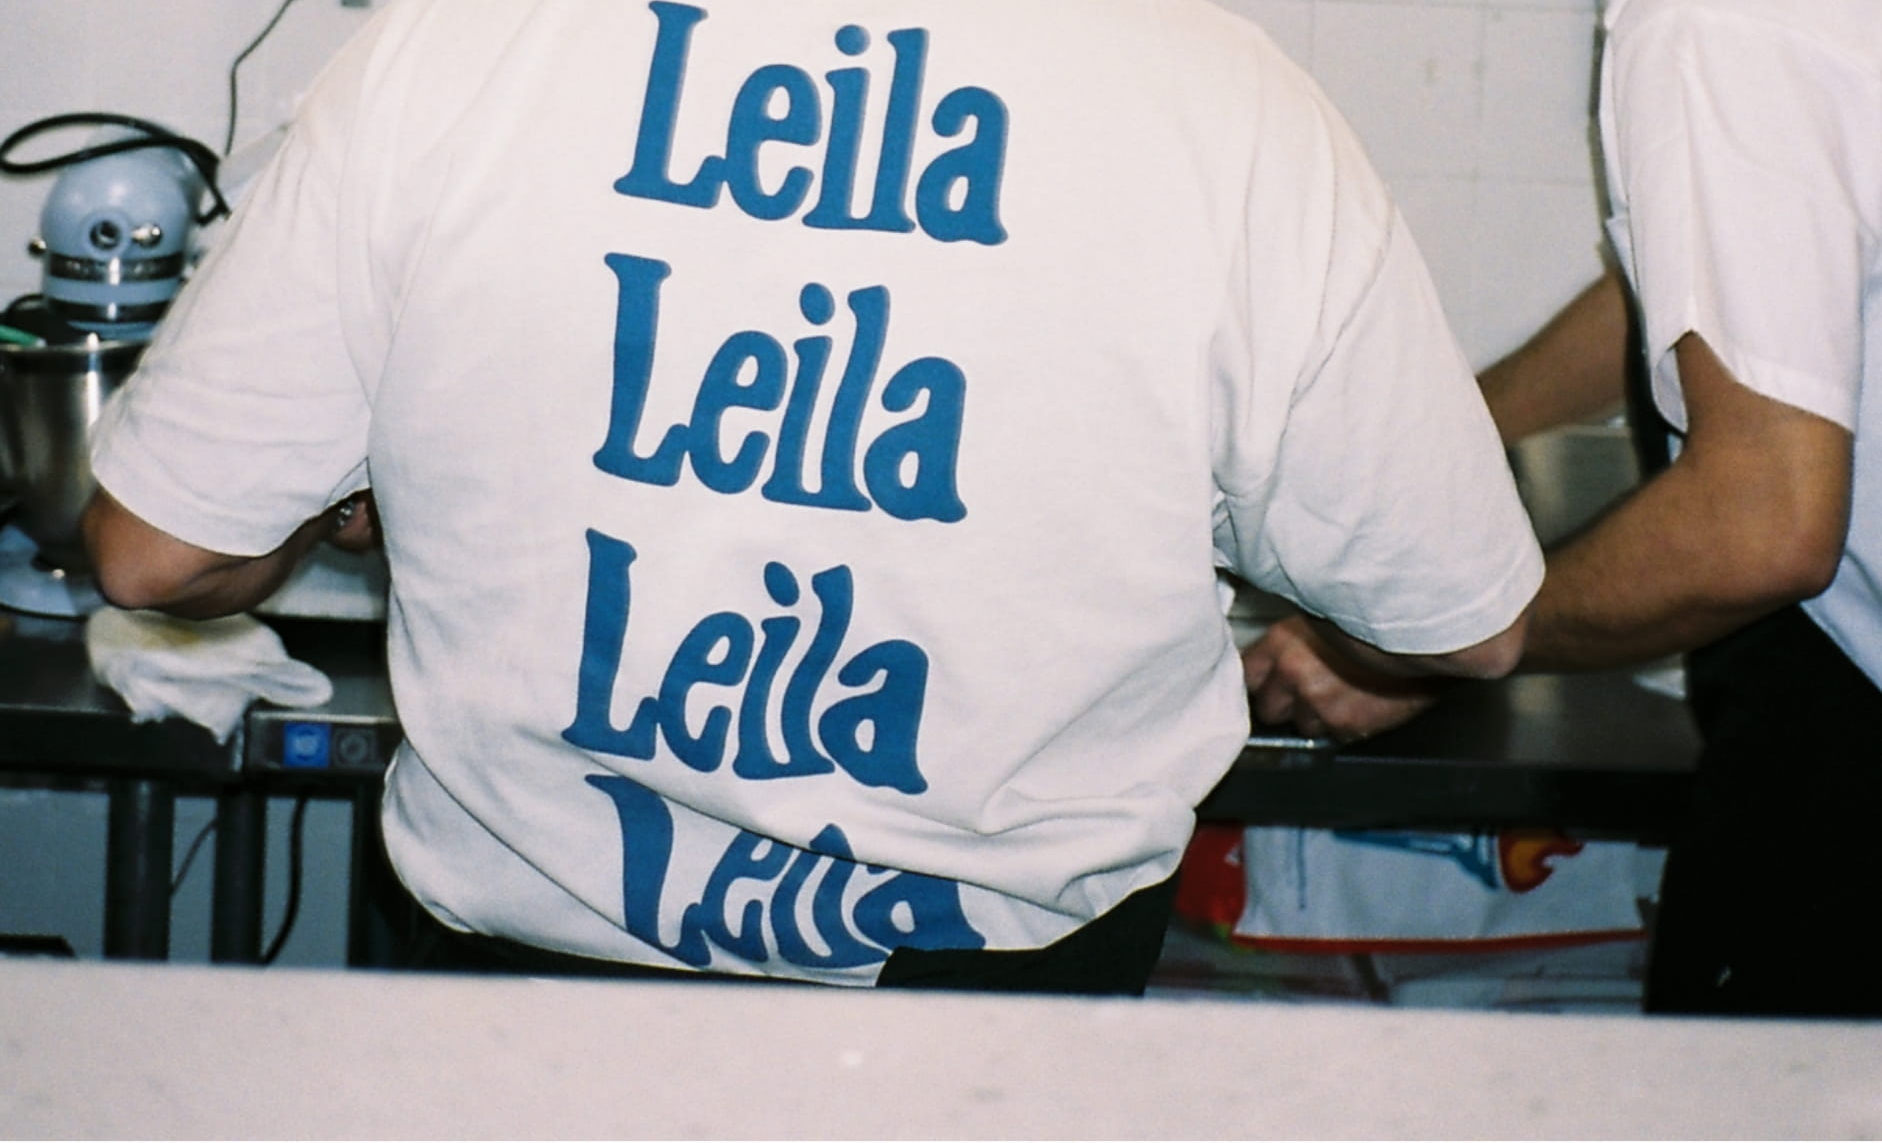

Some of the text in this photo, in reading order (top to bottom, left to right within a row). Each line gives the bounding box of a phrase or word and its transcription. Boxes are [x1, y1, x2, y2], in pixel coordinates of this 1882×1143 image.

[613, 0, 1008, 246] Leila
[592, 252, 967, 524] Leila
[561, 527, 929, 796] Leila
